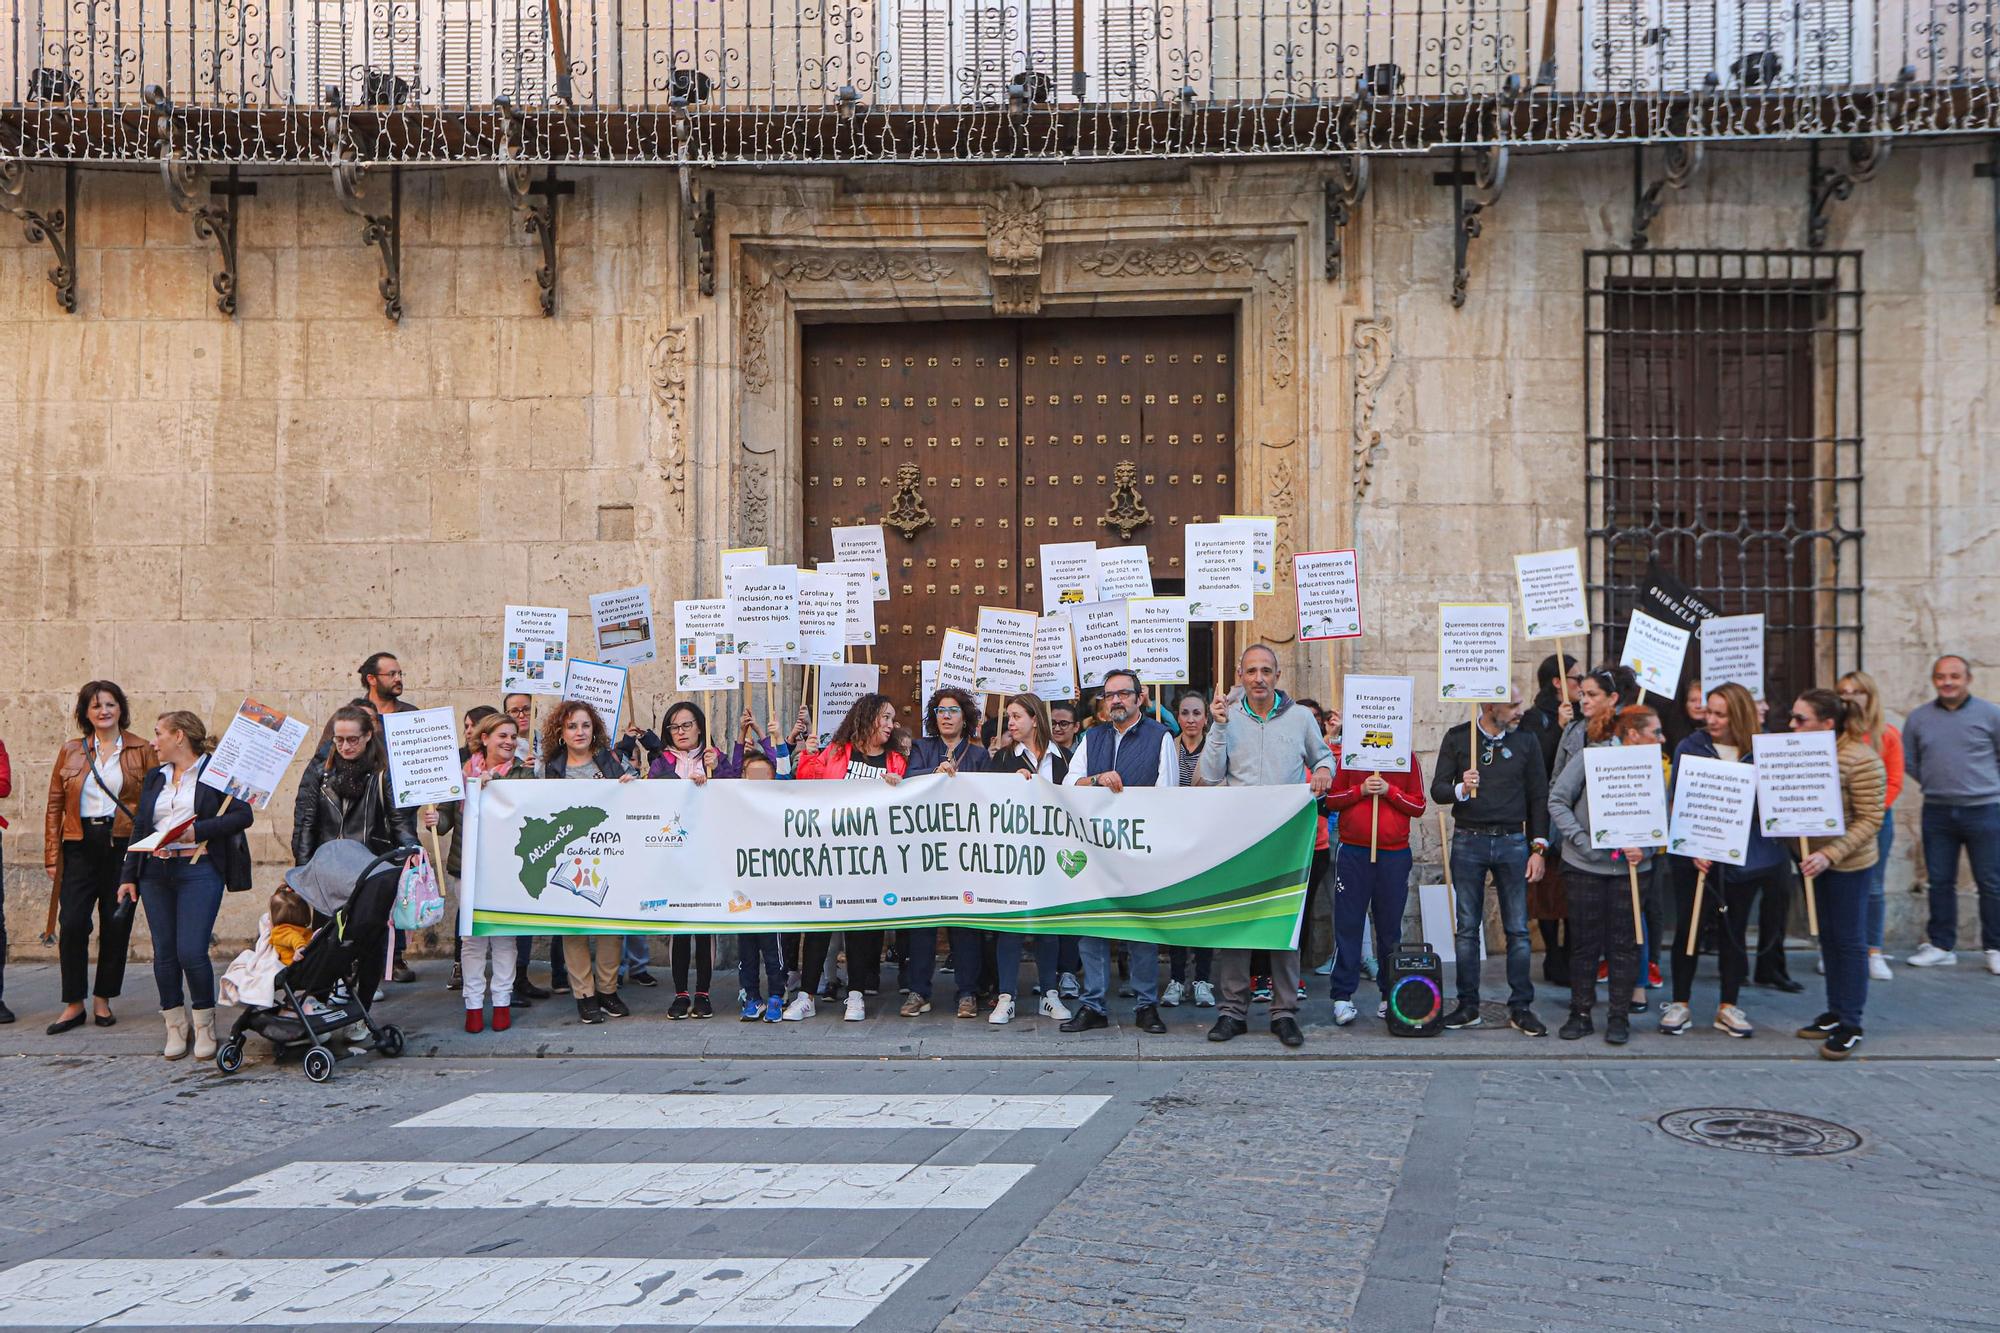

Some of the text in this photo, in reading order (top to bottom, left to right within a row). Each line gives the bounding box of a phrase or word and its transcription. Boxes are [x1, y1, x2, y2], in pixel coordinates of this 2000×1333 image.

[1311, 561, 1343, 569] palmeras
[1319, 569, 1345, 577] centros
[1299, 580, 1335, 588] educativos
[1310, 589, 1320, 597] las
[1321, 588, 1338, 596] cuida
[815, 599, 830, 607] aquí
[1334, 596, 1353, 606] hij@s
[1097, 610, 1114, 619] plan
[1157, 607, 1170, 615] hay
[1300, 608, 1309, 616] se
[1308, 607, 1332, 616] juegan
[1008, 620, 1020, 628] hay
[1086, 621, 1119, 631] Edificant
[980, 628, 1034, 638] mantenimiento
[1004, 639, 1032, 648] centros
[994, 657, 1016, 665] tenéis
[1363, 695, 1400, 703] transporte
[414, 716, 426, 724] Sin
[1387, 713, 1403, 721] para
[402, 755, 449, 766] acabaremos
[410, 767, 432, 775] todos
[626, 814, 651, 822] Integrada
[784, 799, 1152, 853] POR UNA ESCUELA PÚBLICA, LIBRE,
[590, 832, 621, 844] FAPA
[645, 835, 683, 843] COVAPA
[528, 823, 574, 864] Alicante
[567, 847, 601, 856] Gabriel
[737, 842, 1045, 877] DEMOCRÁTICA Y DE CALIDAD
